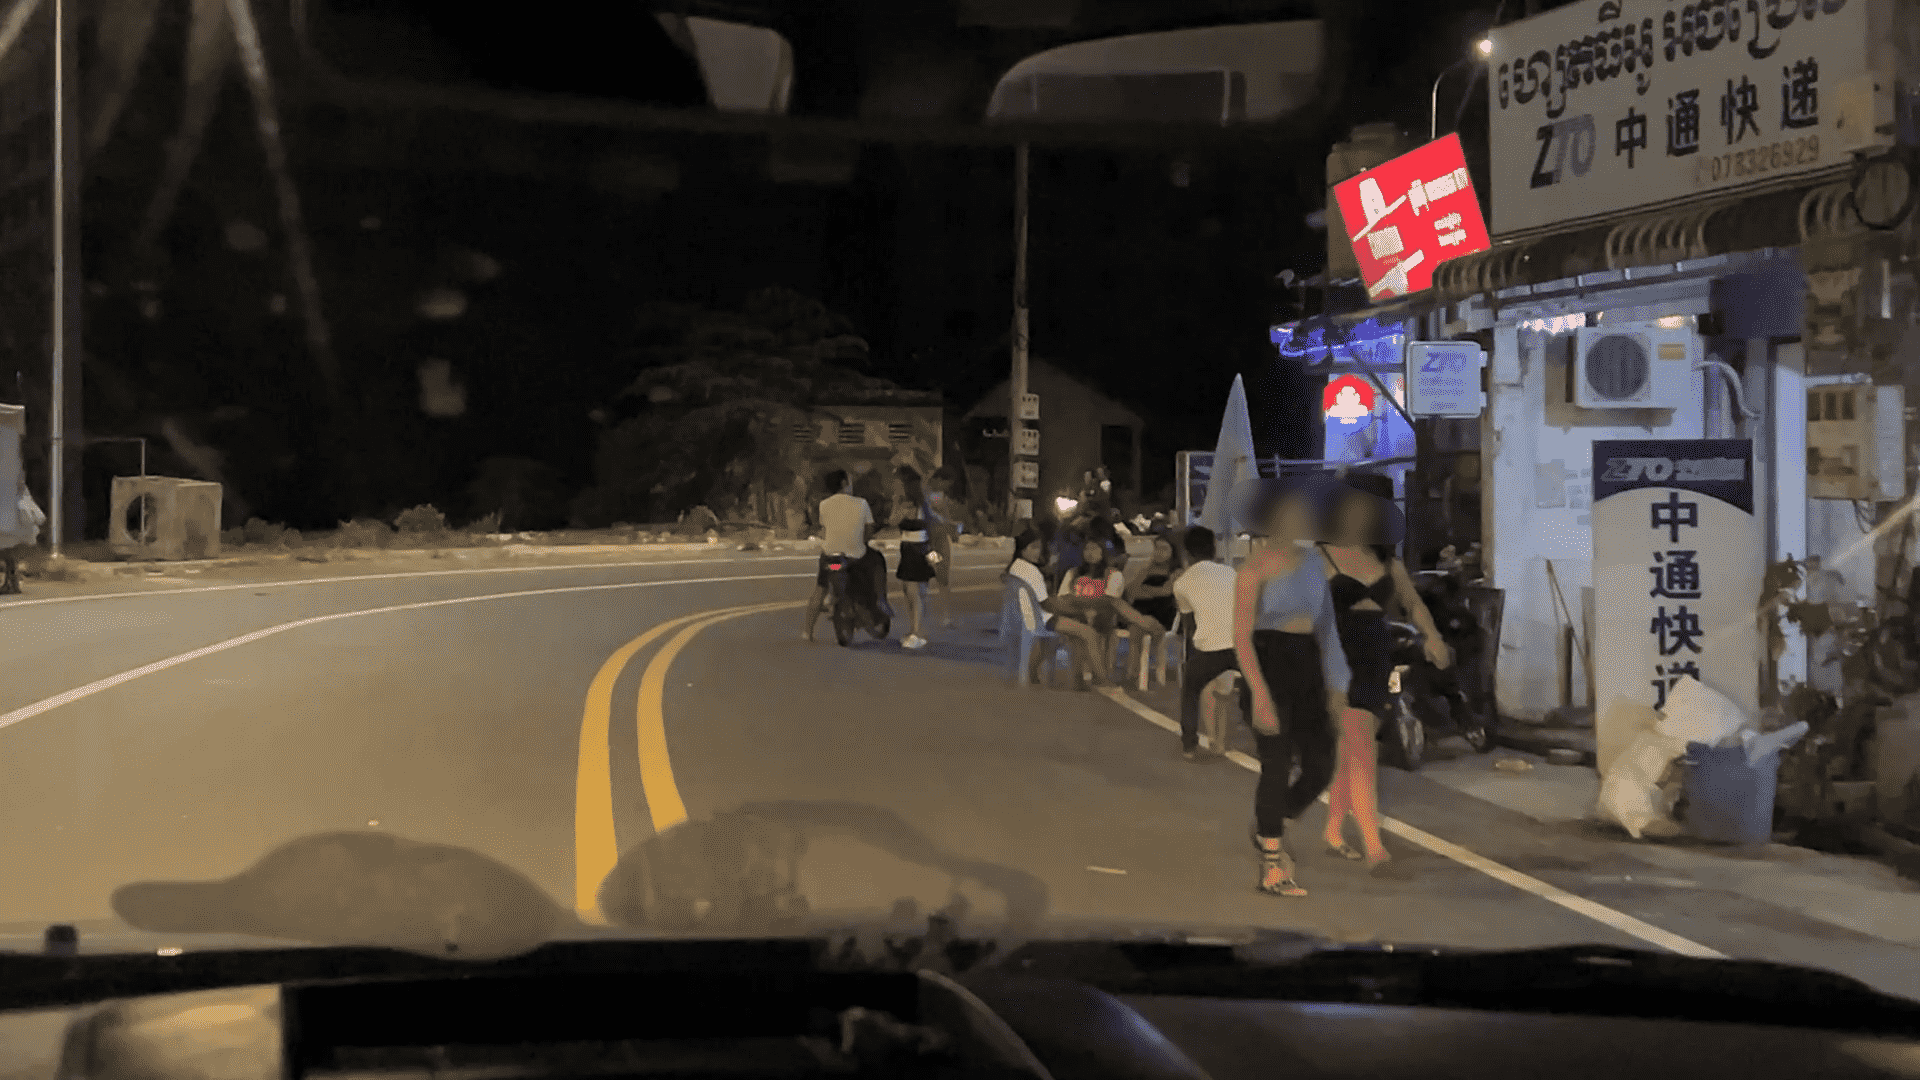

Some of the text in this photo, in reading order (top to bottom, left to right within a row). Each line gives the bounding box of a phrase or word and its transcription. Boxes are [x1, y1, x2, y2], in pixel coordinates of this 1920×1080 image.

[1615, 56, 1820, 169] 中通快递
[1529, 114, 1597, 189] ZTO
[1600, 457, 1674, 482] ZTO
